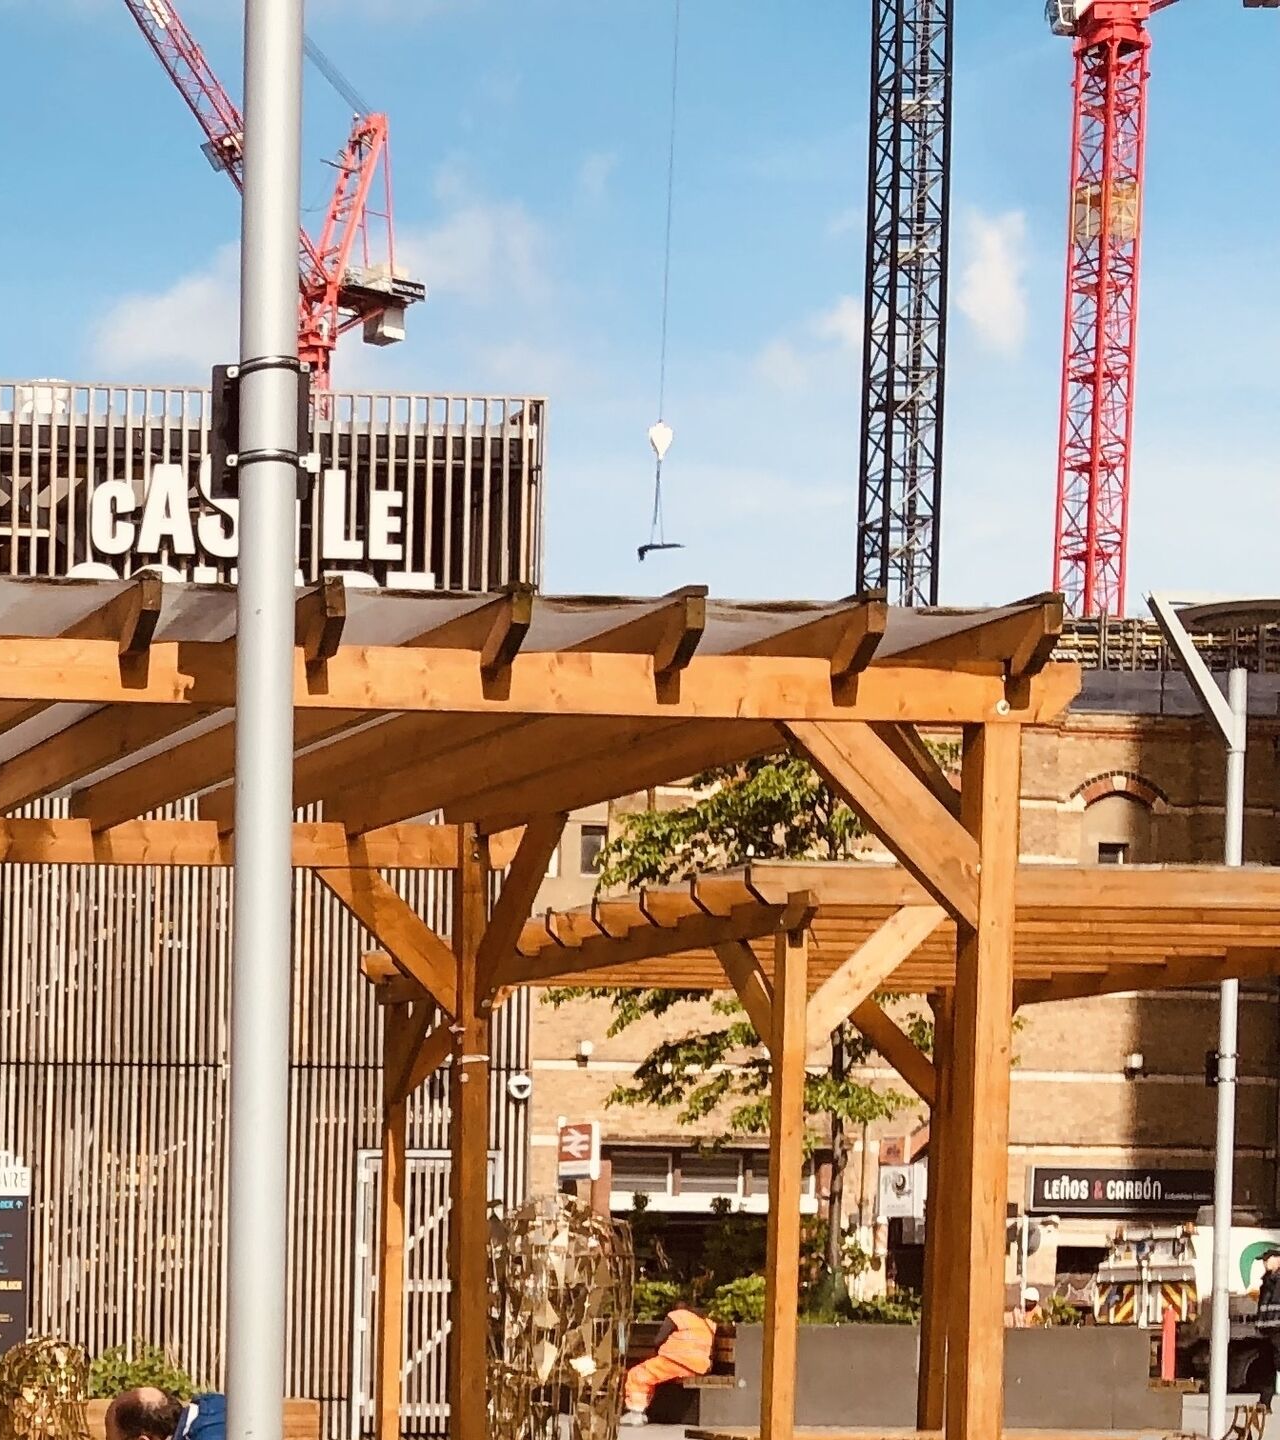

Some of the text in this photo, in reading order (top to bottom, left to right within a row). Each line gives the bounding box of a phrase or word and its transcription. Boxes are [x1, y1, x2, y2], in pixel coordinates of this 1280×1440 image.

[91, 453, 403, 561] CASLE
[1043, 1174, 1162, 1200] LEÑOS & CARBÓN
